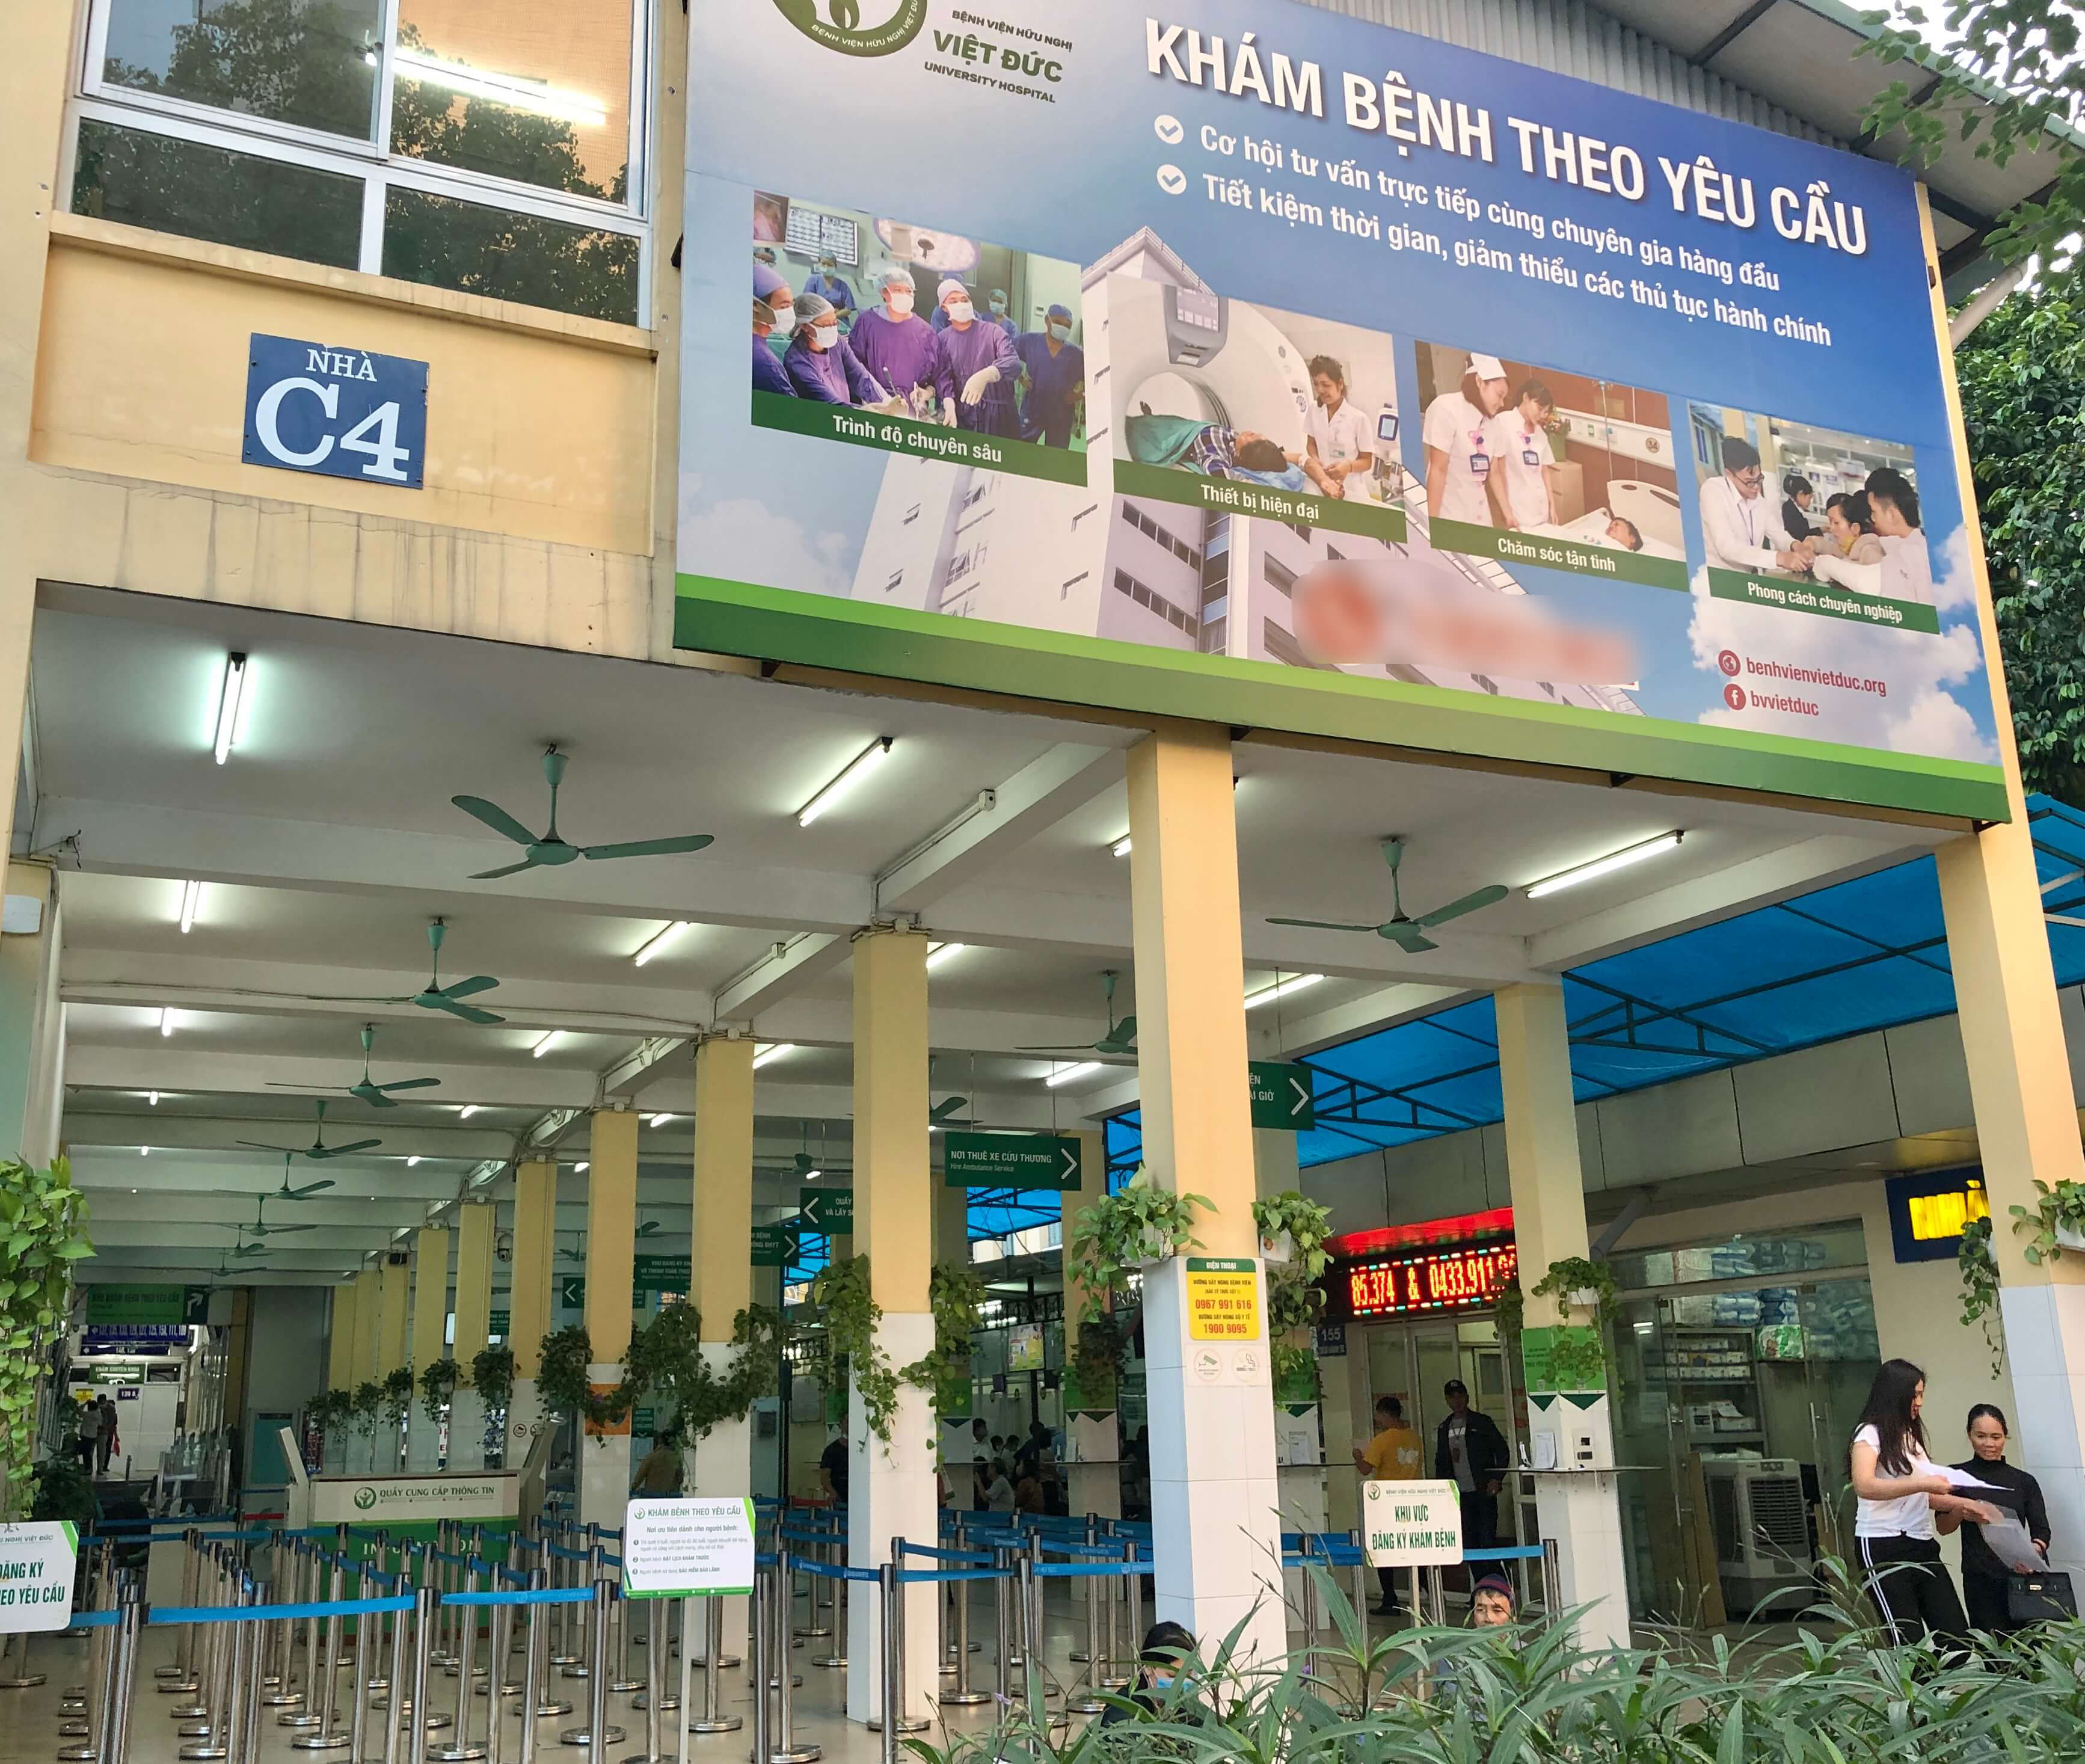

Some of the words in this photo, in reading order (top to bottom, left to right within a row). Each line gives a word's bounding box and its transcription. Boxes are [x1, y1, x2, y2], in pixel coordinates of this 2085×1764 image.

[952, 10, 985, 26] BỆNH
[987, 19, 1014, 34] VIỆN
[1016, 28, 1043, 41] HỮU
[1044, 35, 1072, 52] NGHỊ
[933, 29, 997, 65] VIỆT
[1001, 51, 1063, 82] ĐỨC
[924, 61, 997, 87] UNIVERSITY
[998, 81, 1055, 103] HOSPITAL
[1146, 17, 1323, 117] KHÁM
[1342, 70, 1493, 162] BỆNH
[1508, 116, 1645, 200] THEO
[1657, 155, 1755, 228] YÊU
[1770, 180, 1867, 255] CẦU
[1200, 125, 1236, 156] Cơ
[1244, 135, 1283, 173] hội
[1291, 148, 1319, 177] tư
[1325, 160, 1371, 191] vấn
[1378, 171, 1429, 207] trực
[1436, 185, 1481, 222] tiếp
[1487, 201, 1544, 240] cùng
[1552, 217, 1633, 257] chuyên
[1639, 239, 1672, 266] gia
[1678, 246, 1733, 286] hàng
[1739, 260, 1780, 291] đầu
[1203, 173, 1253, 211] Tiết
[1261, 188, 1322, 227] kiệm
[1330, 206, 1380, 241] thời
[1388, 223, 1448, 262] gian,
[1455, 239, 1512, 274] giảm
[1519, 253, 1577, 289] thiểu
[1585, 271, 1625, 300] các
[1630, 279, 1667, 309] thủ
[1672, 289, 1709, 322] tục
[1714, 298, 1768, 333] hành
[1773, 314, 1831, 347] chính
[306, 348, 377, 383] NHÀ
[256, 377, 410, 481] C4
[832, 414, 876, 440] Trình
[881, 426, 903, 449] độ
[907, 431, 968, 458] chuyên
[972, 444, 1003, 463] sâu
[1201, 484, 1239, 508] Thiết
[1242, 494, 1257, 513] bị
[1261, 497, 1292, 520] hiện
[1297, 502, 1319, 523] đại
[1498, 537, 1537, 559] Chăm
[1540, 544, 1564, 562] sóc
[1566, 550, 1588, 570] tận
[1590, 554, 1616, 573] tình
[1748, 582, 1786, 605] Phong
[1788, 589, 1817, 607] cách
[1819, 594, 1862, 616] chuyên
[1863, 603, 1903, 624] nghiệp
[1746, 657, 1887, 697] benhvienvietduc.org
[1751, 690, 1820, 716] bvvietduc
[967, 1151, 987, 1160] THUÊ
[1001, 1151, 1018, 1162] CỨU
[1021, 1154, 1052, 1163] THƯƠNG
[1195, 1299, 1215, 1309] 0967
[1218, 1299, 1233, 1309] 991
[1236, 1299, 1251, 1309] 616
[1203, 1324, 1224, 1333] 1900
[1226, 1324, 1247, 1333] 9095
[1321, 1327, 1340, 1341] 155
[451, 1486, 479, 1495] THÔNG
[648, 1507, 669, 1516] KHÁM
[671, 1507, 690, 1517] BỆNH
[711, 1507, 725, 1516] YÊU
[1395, 1505, 1411, 1522] KHU
[1413, 1504, 1428, 1525] VỰC
[1372, 1529, 1395, 1550] ĐĂNG
[1397, 1529, 1407, 1549] KÝ
[1410, 1528, 1432, 1549] KHÁM
[1436, 1527, 1456, 1552] BỆNH
[29, 1558, 44, 1578] KÝ
[19, 1584, 40, 1605] YÊU
